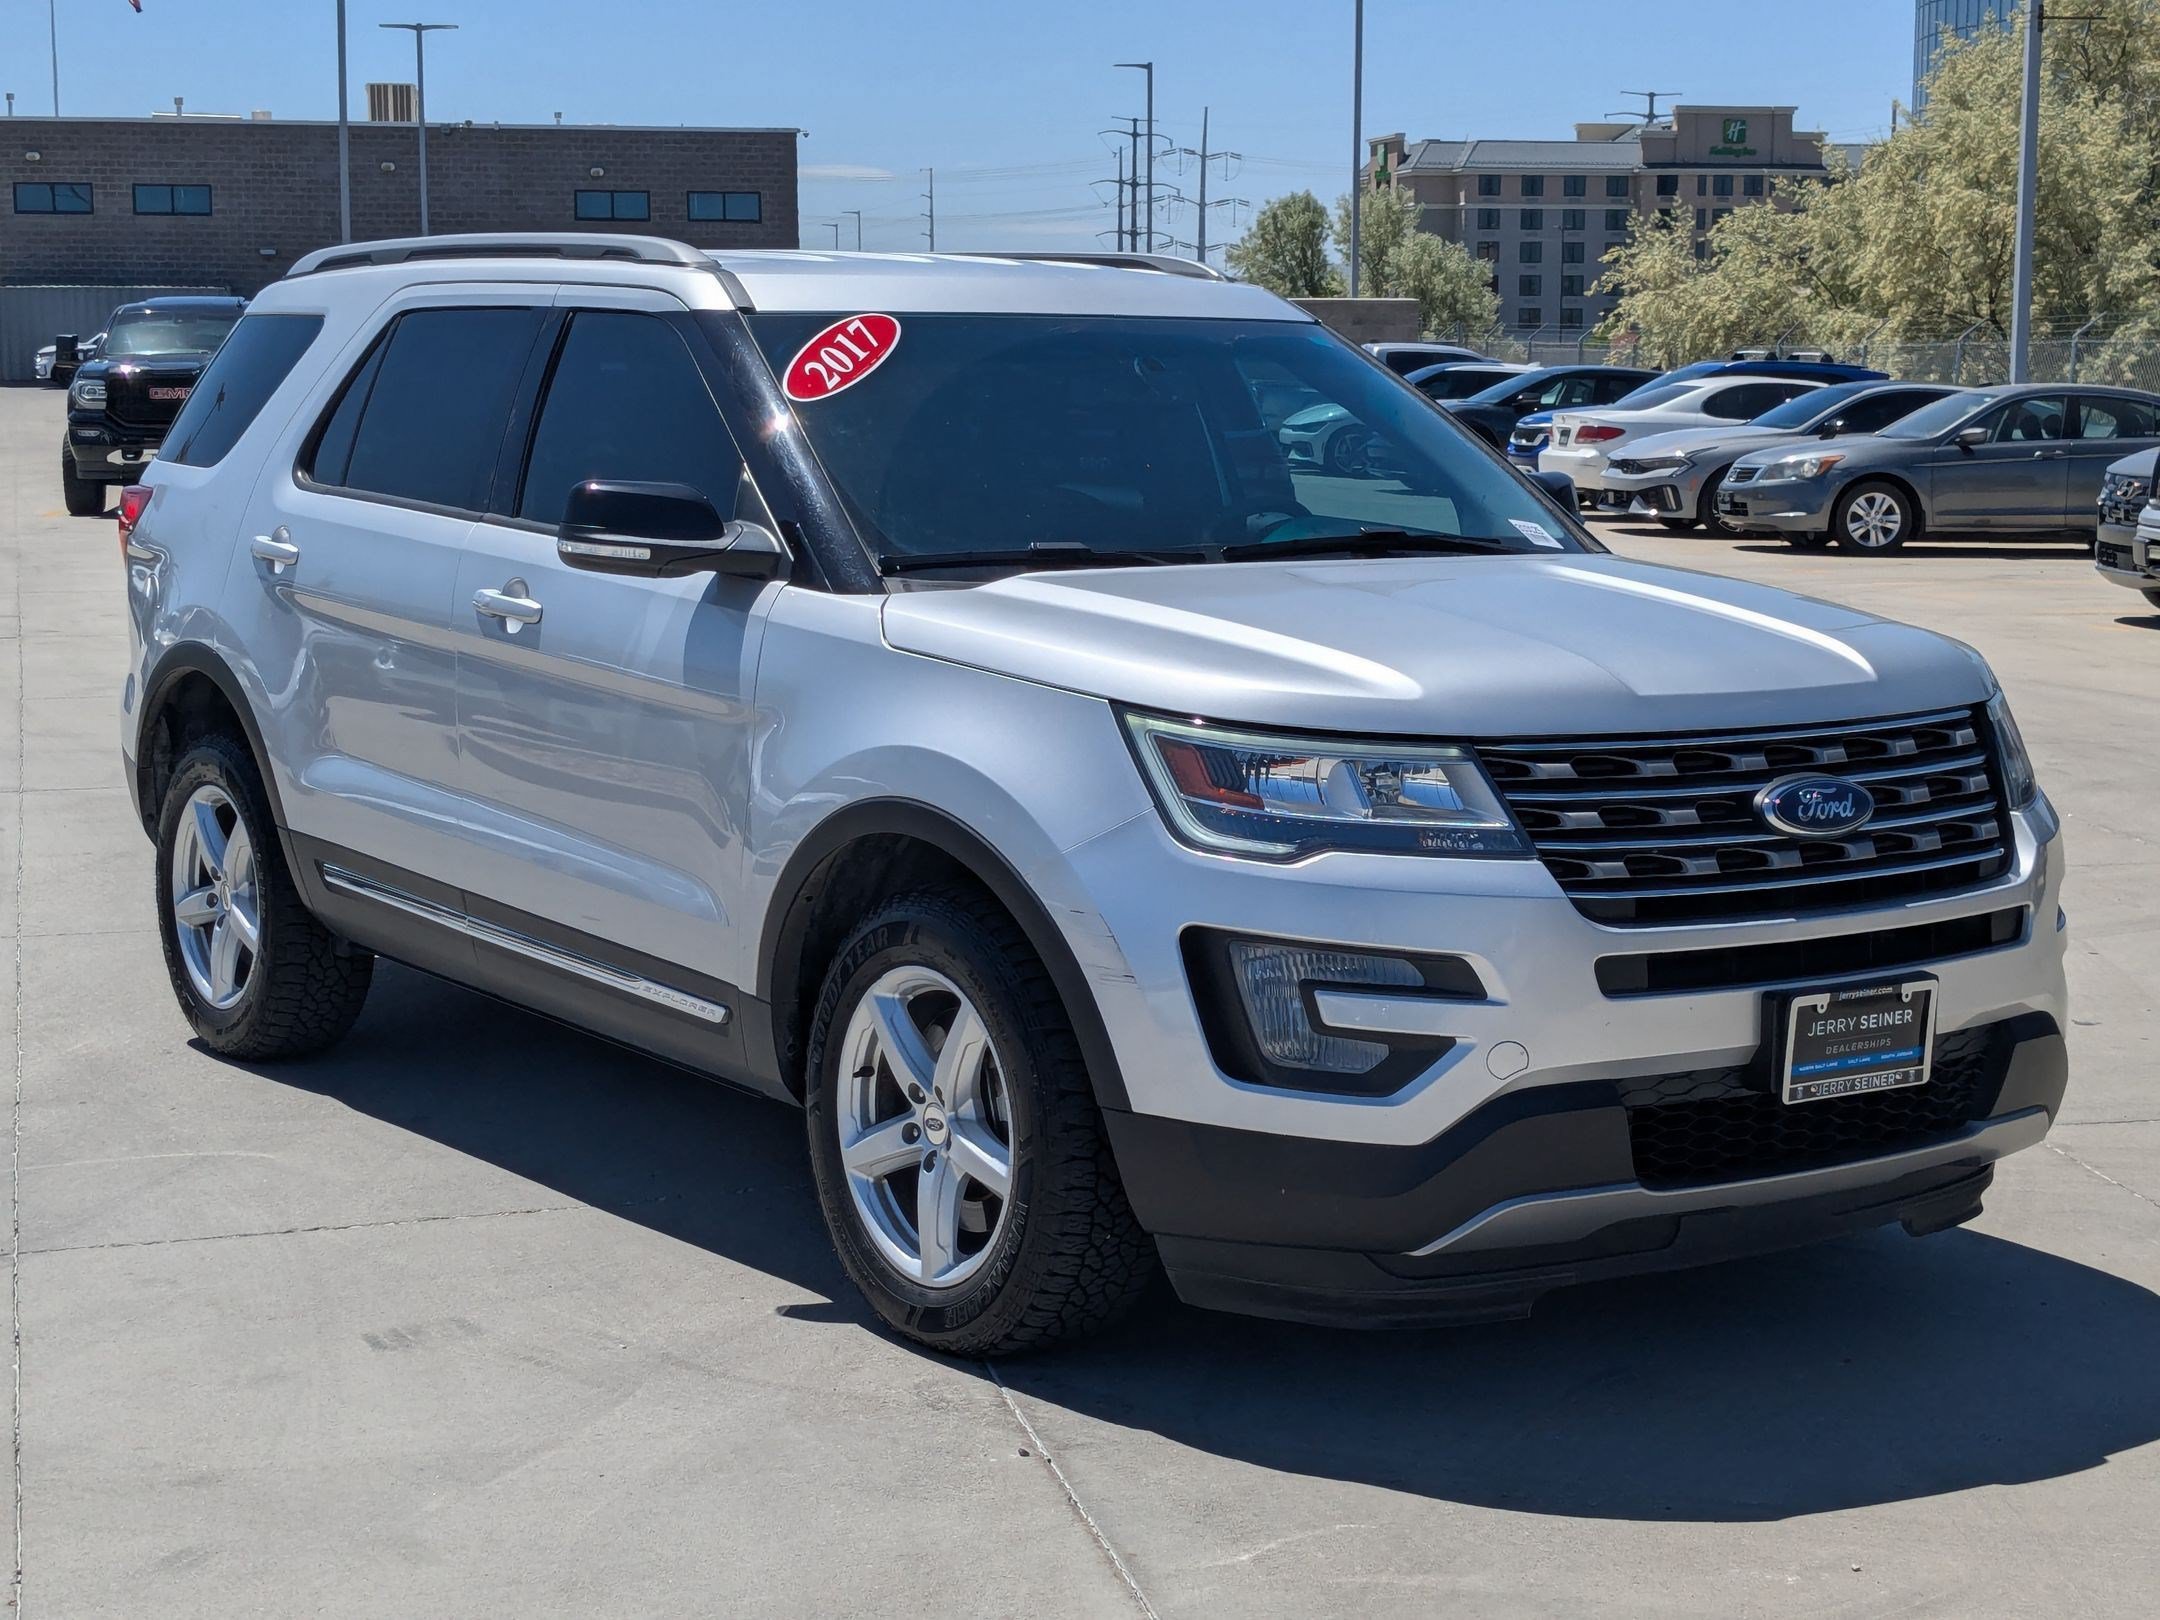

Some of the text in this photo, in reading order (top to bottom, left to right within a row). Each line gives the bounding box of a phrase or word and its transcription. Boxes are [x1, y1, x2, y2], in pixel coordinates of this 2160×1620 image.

[804, 318, 879, 390] 2017
[1798, 787, 1856, 822] Ford
[642, 985, 716, 1017] EXPLORER
[811, 926, 889, 1064] GOODYEAR
[1838, 986, 1893, 1001] jerryseiner.com
[1807, 1009, 1914, 1038] JERRY SEINER
[1825, 1038, 1892, 1054] DEALERSHIPS
[1816, 1079, 1852, 1096] JERRY
[1854, 1072, 1895, 1090] SEINER
[944, 1199, 1029, 1329] WRANGLER
